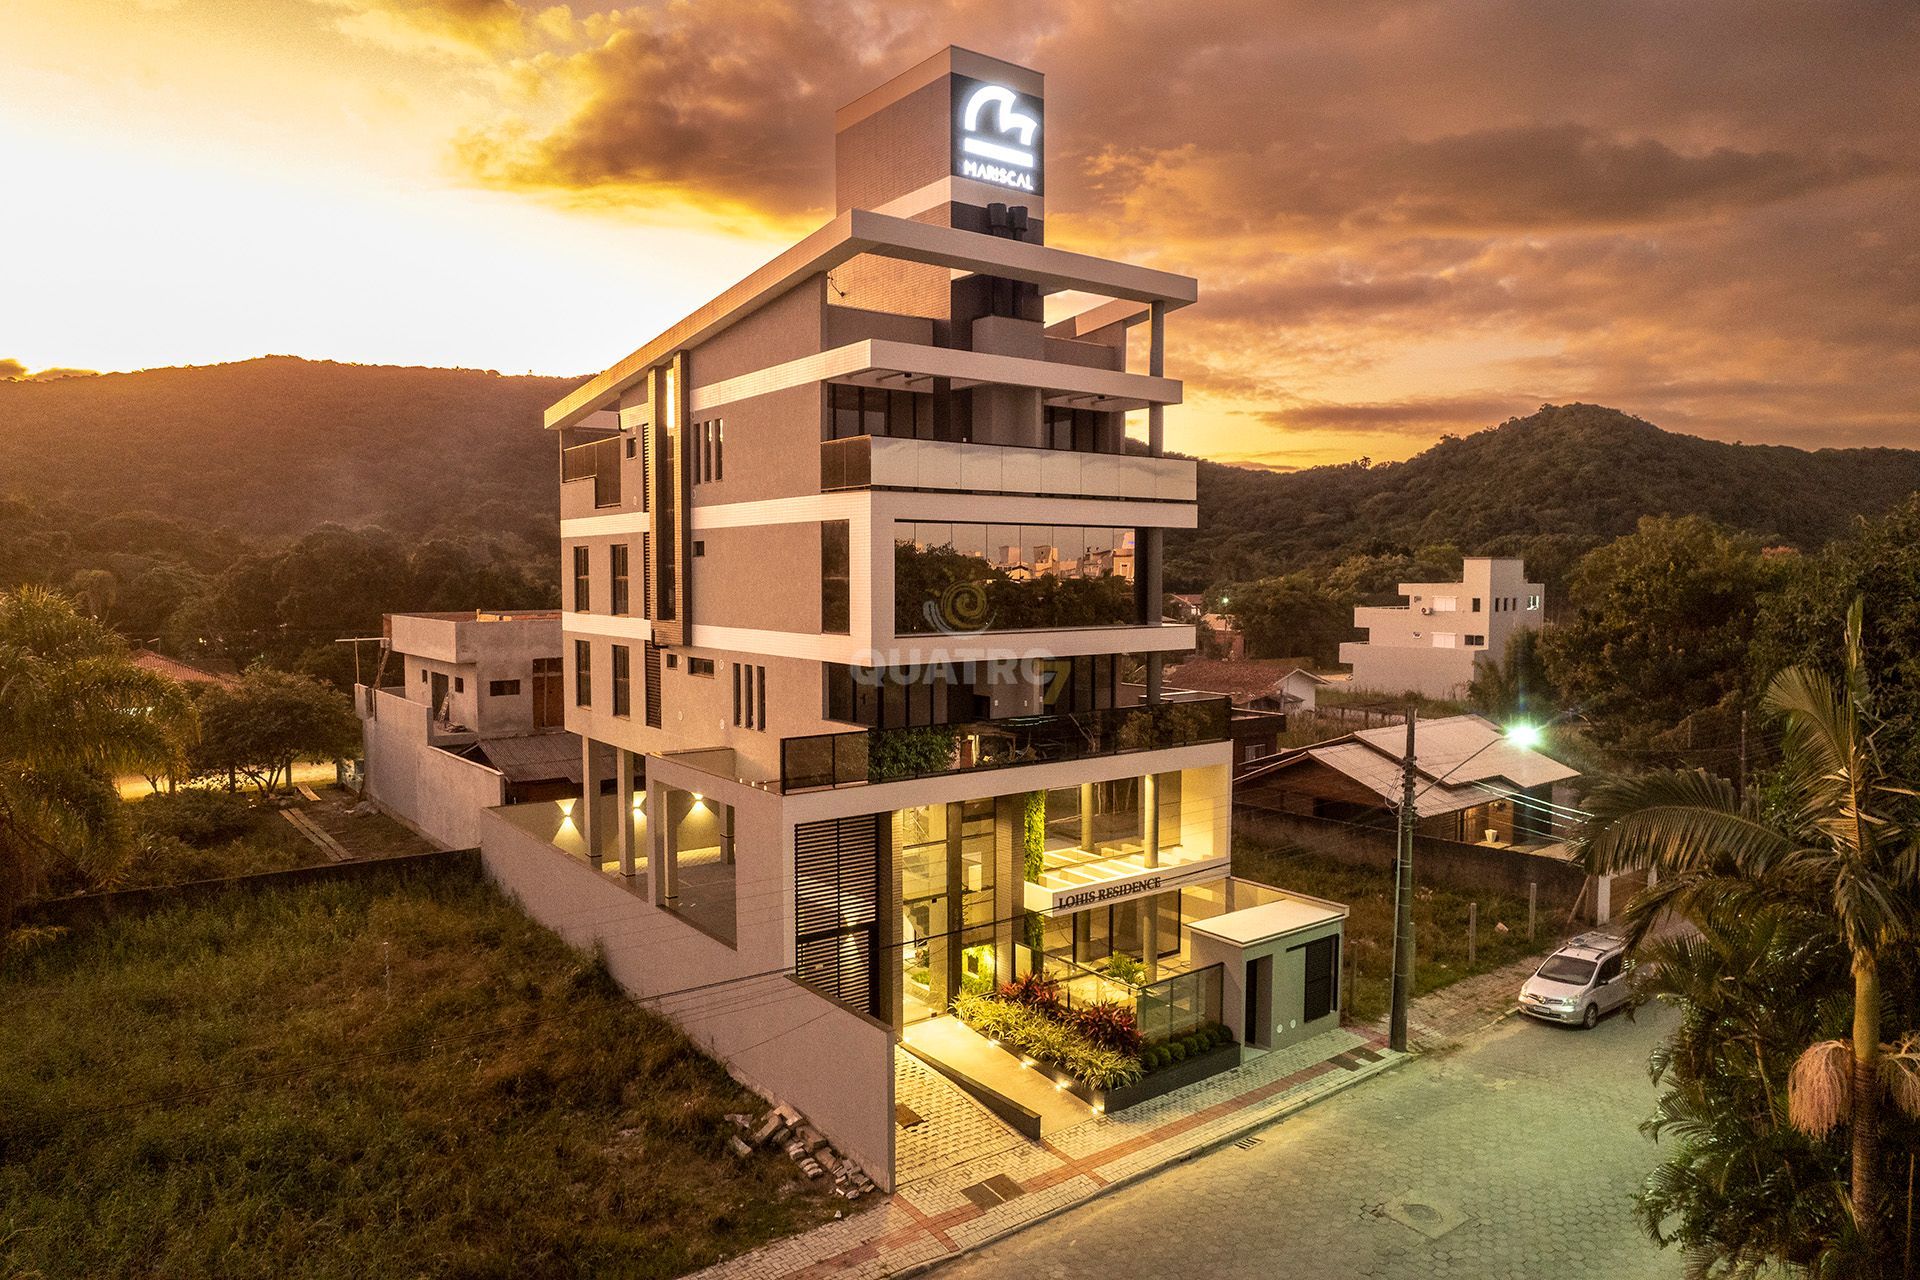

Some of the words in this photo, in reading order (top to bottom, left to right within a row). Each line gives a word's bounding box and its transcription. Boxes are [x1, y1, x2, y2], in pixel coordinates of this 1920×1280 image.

[963, 159, 1034, 191] MARISCAL
[1058, 891, 1097, 910] LOHIS
[1099, 877, 1162, 901] RESIDENCE
